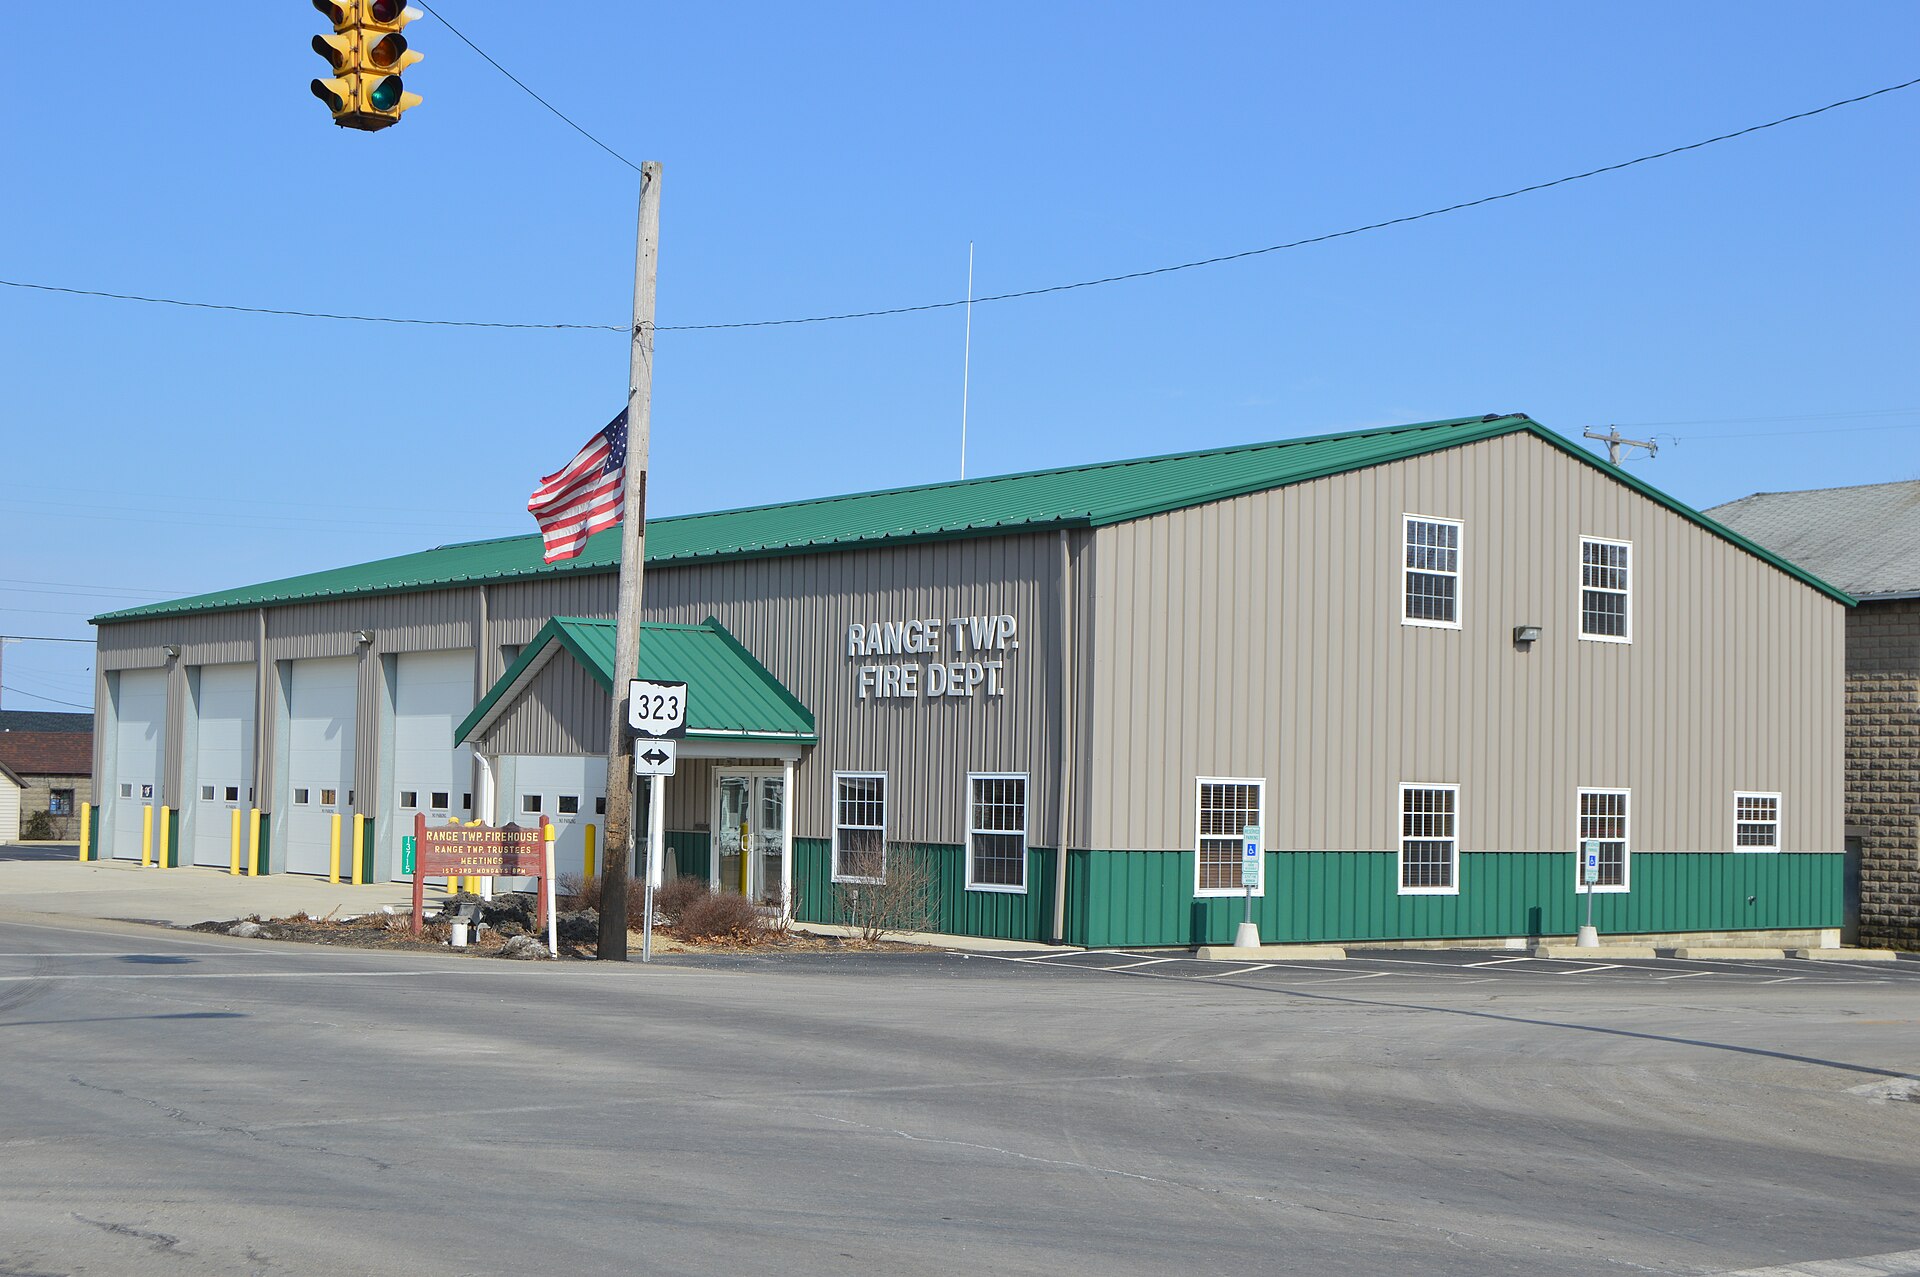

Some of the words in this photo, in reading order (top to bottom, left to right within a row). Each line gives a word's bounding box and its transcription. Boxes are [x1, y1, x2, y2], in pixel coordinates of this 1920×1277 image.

[848, 618, 941, 657] RANGE
[950, 614, 1019, 652] TWP.
[859, 663, 919, 698] FIRE
[927, 660, 1004, 697] DEPT.
[638, 694, 679, 721] 323
[426, 831, 459, 841] RANGE
[462, 831, 484, 842] TWP.
[485, 832, 539, 842] FIREHOUSE
[434, 845, 464, 853] RANGE
[467, 846, 485, 854] TWP.
[487, 846, 531, 854] TRUSTEES
[461, 857, 504, 865] MEETINGS
